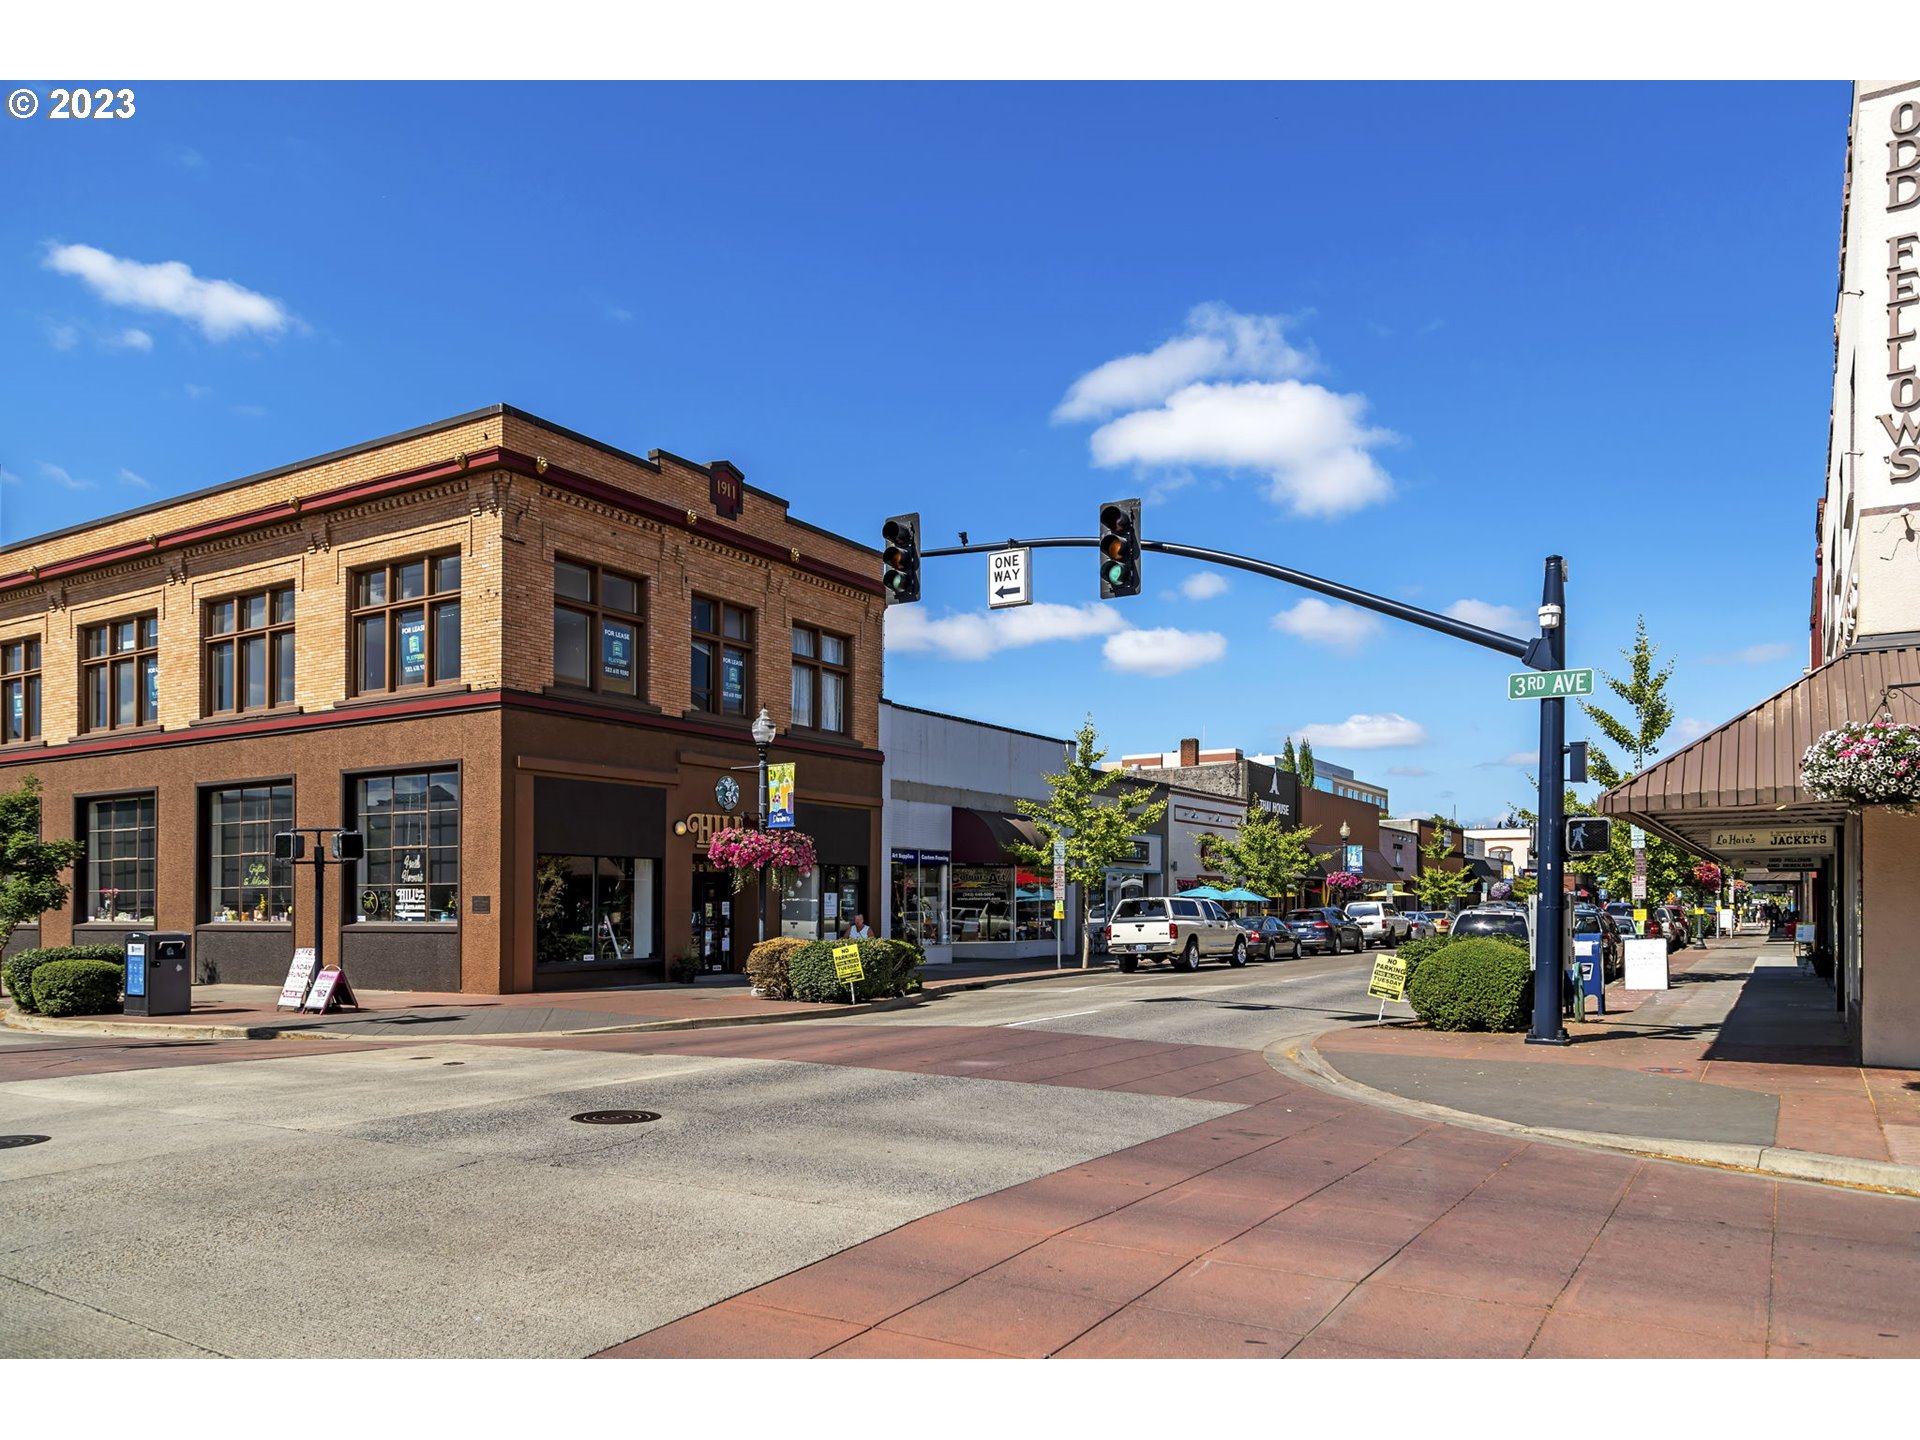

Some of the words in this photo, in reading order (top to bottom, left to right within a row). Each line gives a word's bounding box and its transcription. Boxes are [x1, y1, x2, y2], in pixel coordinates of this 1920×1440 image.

[1886, 100, 1920, 214] ODD
[1875, 231, 1920, 485] FELLOWS
[717, 480, 736, 500] 1911
[995, 554, 1020, 569] ONE
[994, 568, 1020, 583] WAY
[615, 631, 630, 640] LEASE
[1515, 676, 1546, 696] 3RD
[1552, 672, 1587, 694] AVE
[1272, 802, 1290, 816] HOUSE
[1770, 835, 1827, 846] JACKETS
[835, 952, 858, 961] PARKING
[838, 963, 860, 972] TUESDAY
[1376, 963, 1405, 975] PARKING
[1373, 976, 1402, 986] TUESDAY
